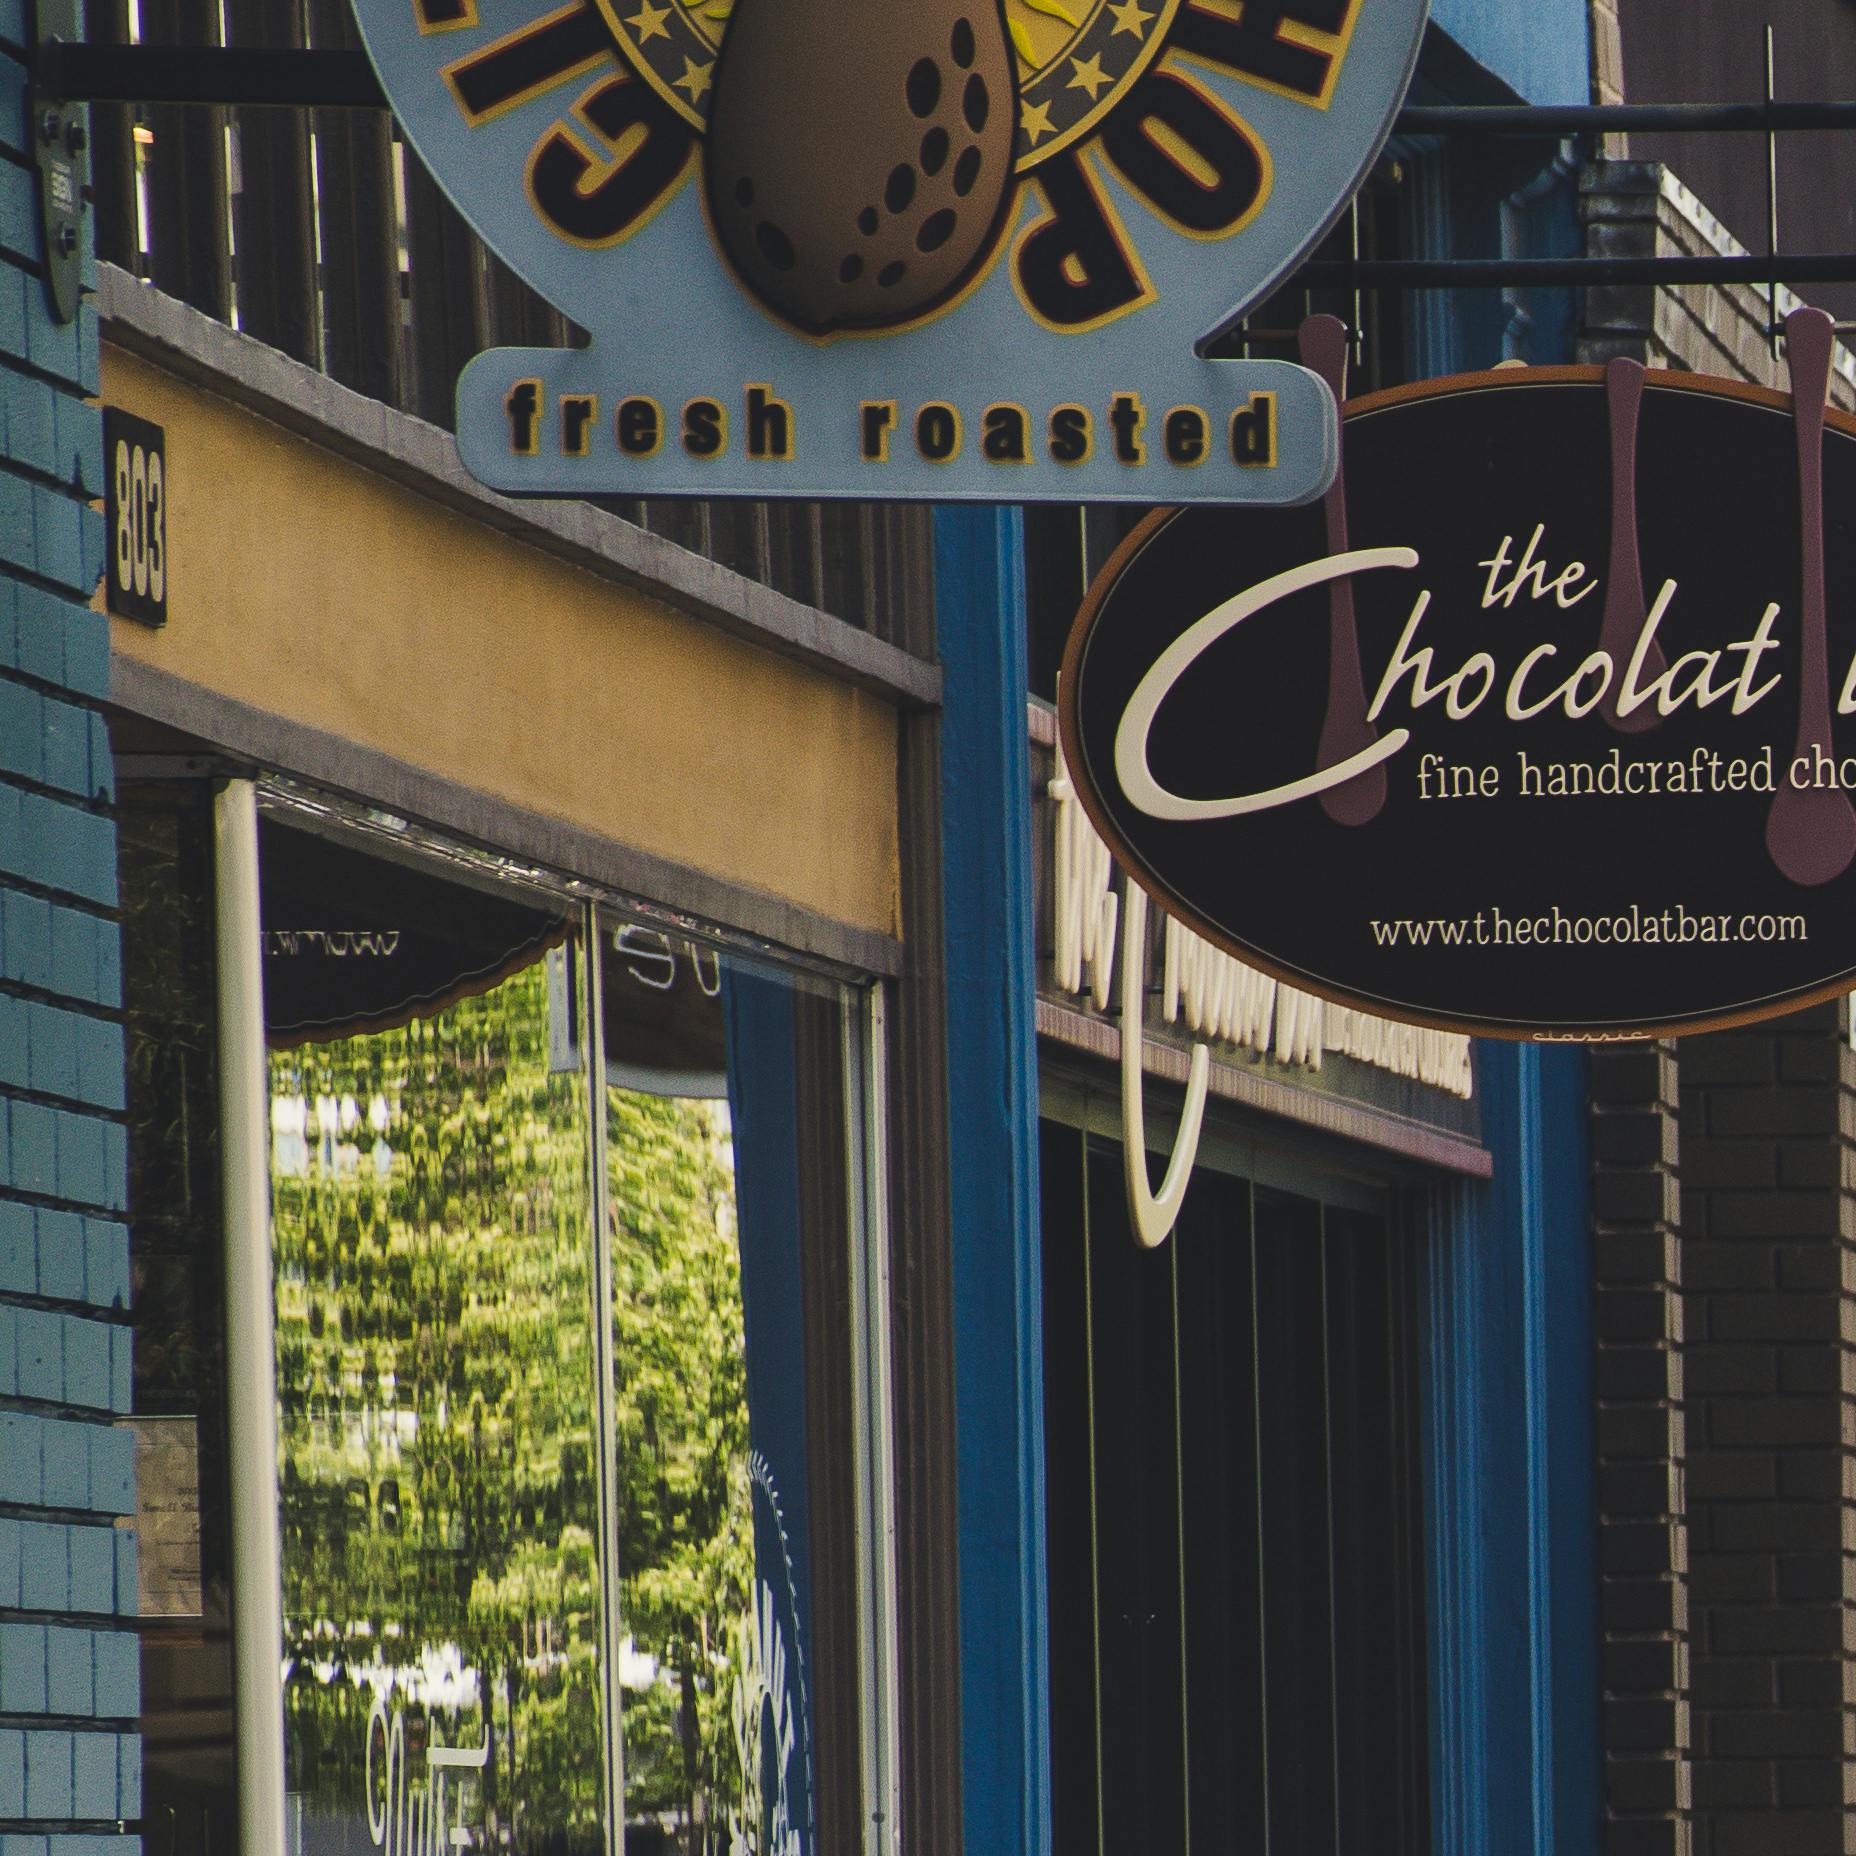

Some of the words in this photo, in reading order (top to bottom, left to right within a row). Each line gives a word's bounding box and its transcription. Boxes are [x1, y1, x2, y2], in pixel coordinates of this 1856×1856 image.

[412, 0, 702, 250] CI
[1010, 0, 1364, 335] HOP
[505, 377, 796, 461] fresh
[859, 390, 1279, 468] roasted
[116, 440, 165, 602] 803
[1478, 523, 1598, 609] the
[1114, 547, 1782, 820] Chocolat
[1417, 753, 1499, 799] fine
[1517, 746, 1777, 797] handcrafted
[1369, 904, 1808, 946] www.thechocolatbar.com
